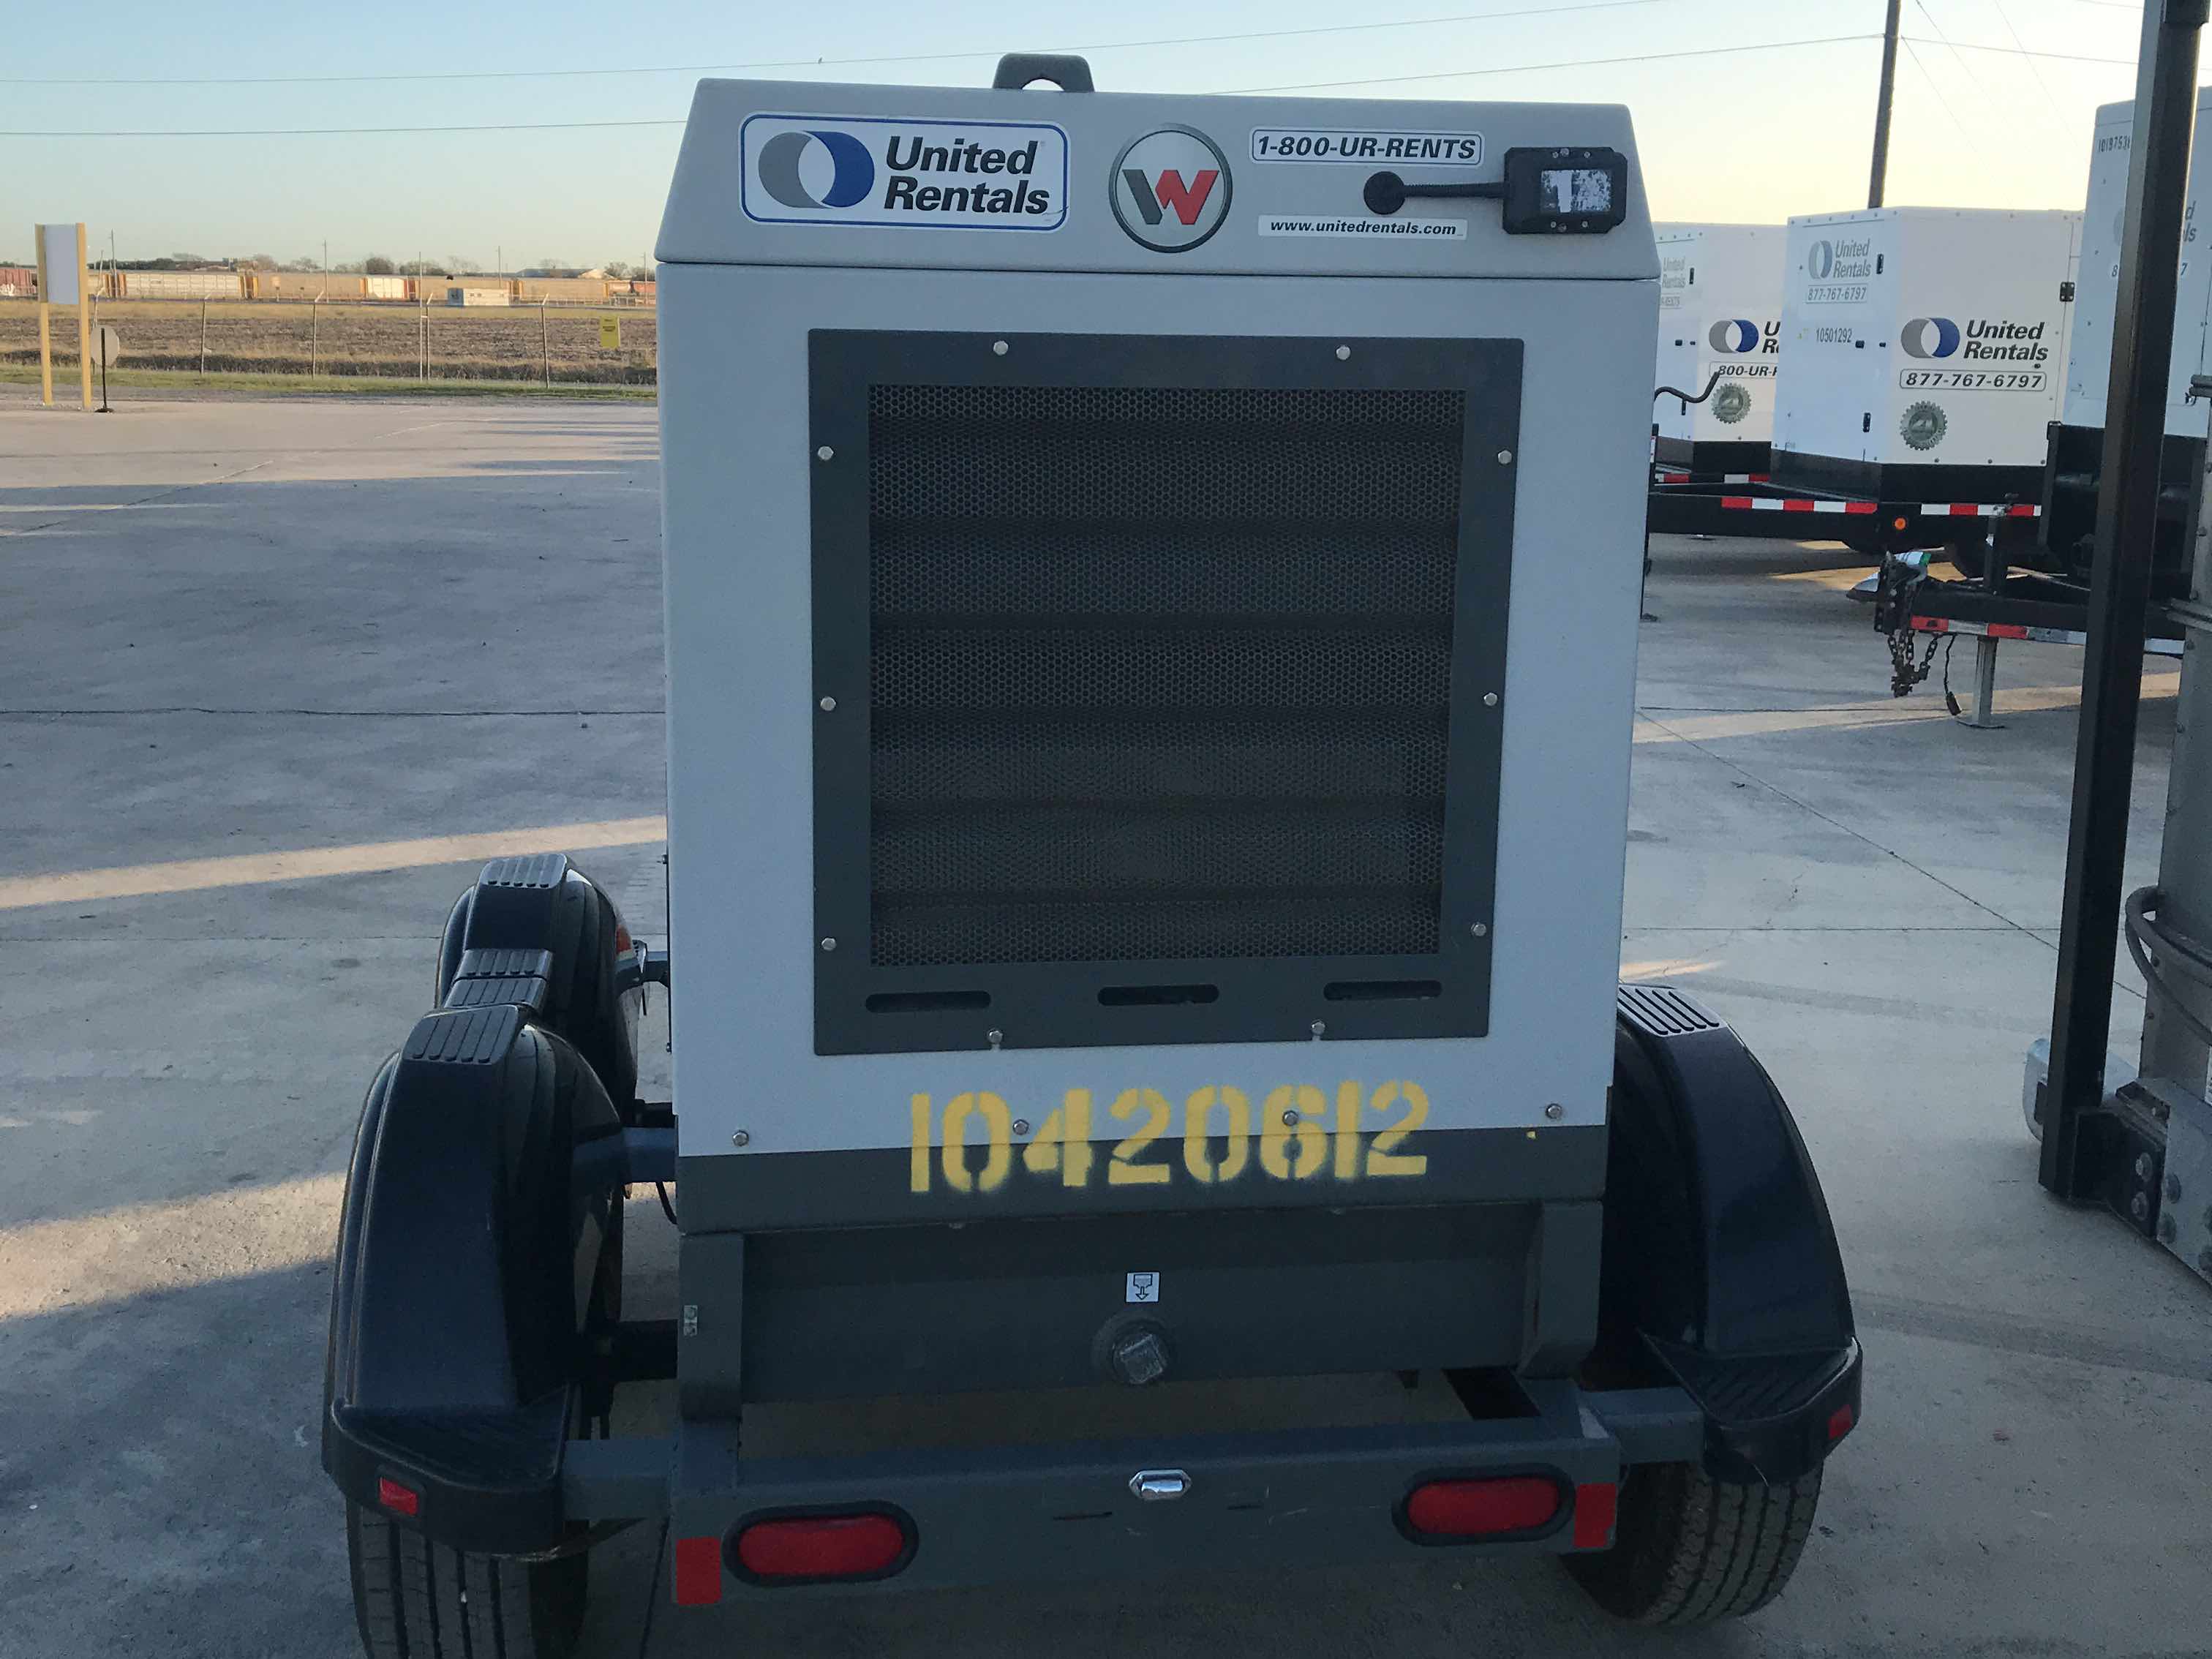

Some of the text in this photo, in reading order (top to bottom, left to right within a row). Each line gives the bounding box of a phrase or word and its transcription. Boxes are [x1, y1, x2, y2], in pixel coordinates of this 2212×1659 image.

[886, 136, 1038, 174] United
[1258, 135, 1476, 159] 1-800-UR-RENTS
[884, 175, 1050, 214] Rentals
[1271, 219, 1456, 236] www.unitedrentals.com
[1835, 238, 1870, 258] United
[1833, 260, 1872, 279] Rentals
[1807, 286, 1867, 301] 877-767-6797
[1816, 327, 1853, 343] 10501292
[1966, 320, 2045, 339] United
[1963, 340, 2048, 361] Rentals
[1906, 372, 2042, 388] 877-767-6797
[911, 1079, 1429, 1193] 10420612
